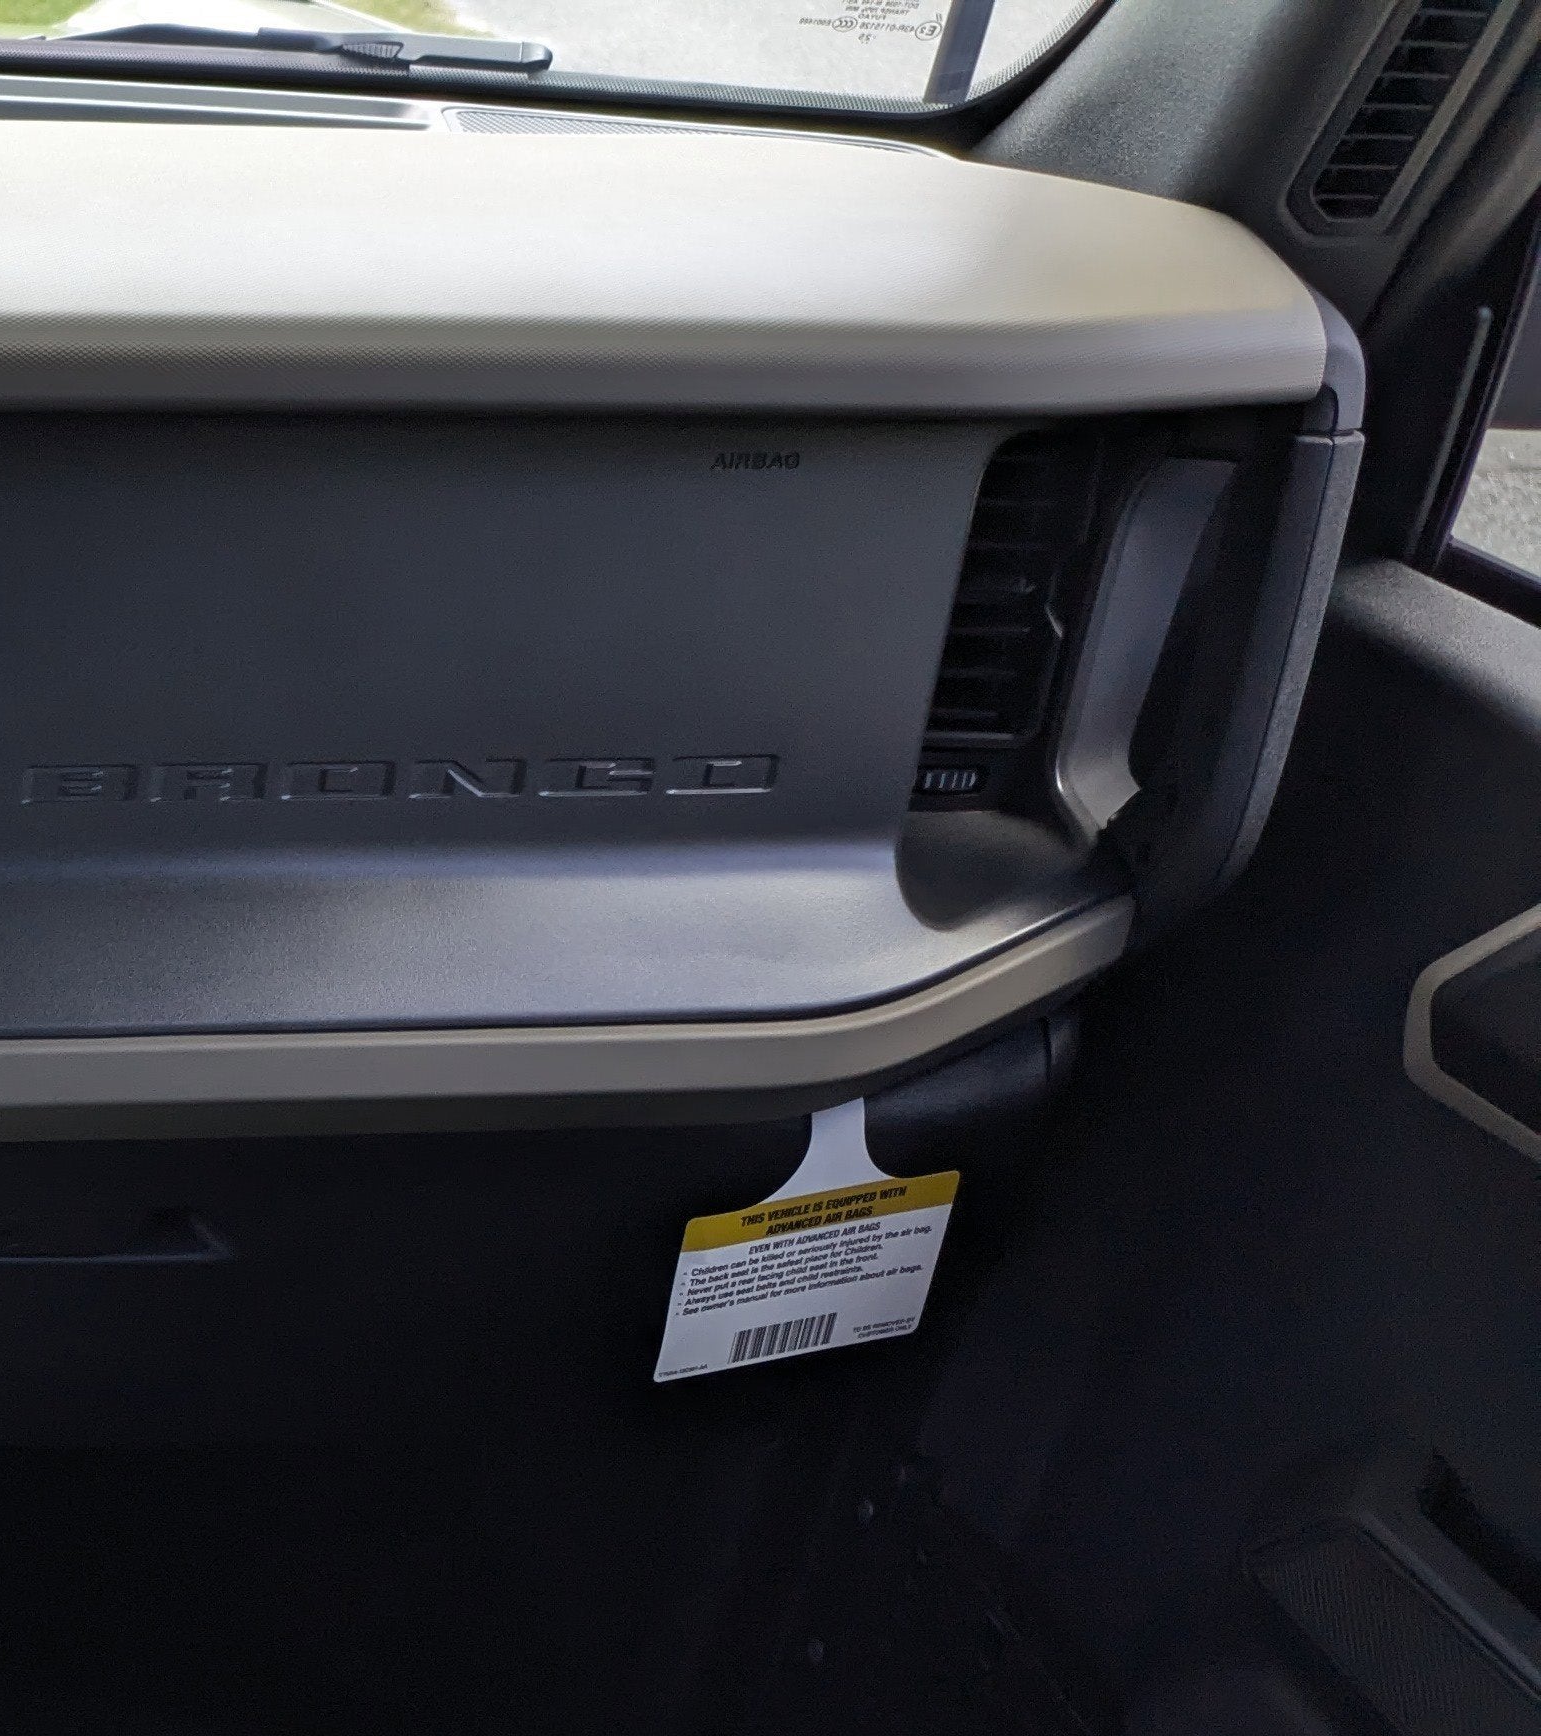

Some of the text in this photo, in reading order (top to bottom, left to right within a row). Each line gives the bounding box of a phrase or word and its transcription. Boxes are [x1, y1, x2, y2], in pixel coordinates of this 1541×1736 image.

[710, 451, 800, 469] AIRBAG
[19, 753, 782, 804] BRONCO
[740, 1186, 906, 1226] THIS VEHICLE IS EQUIPPED WITH
[766, 1206, 873, 1234] ADVANCED AIR BAGS
[748, 1221, 880, 1254] EVEN WITH ADVANCED AIR BAGS
